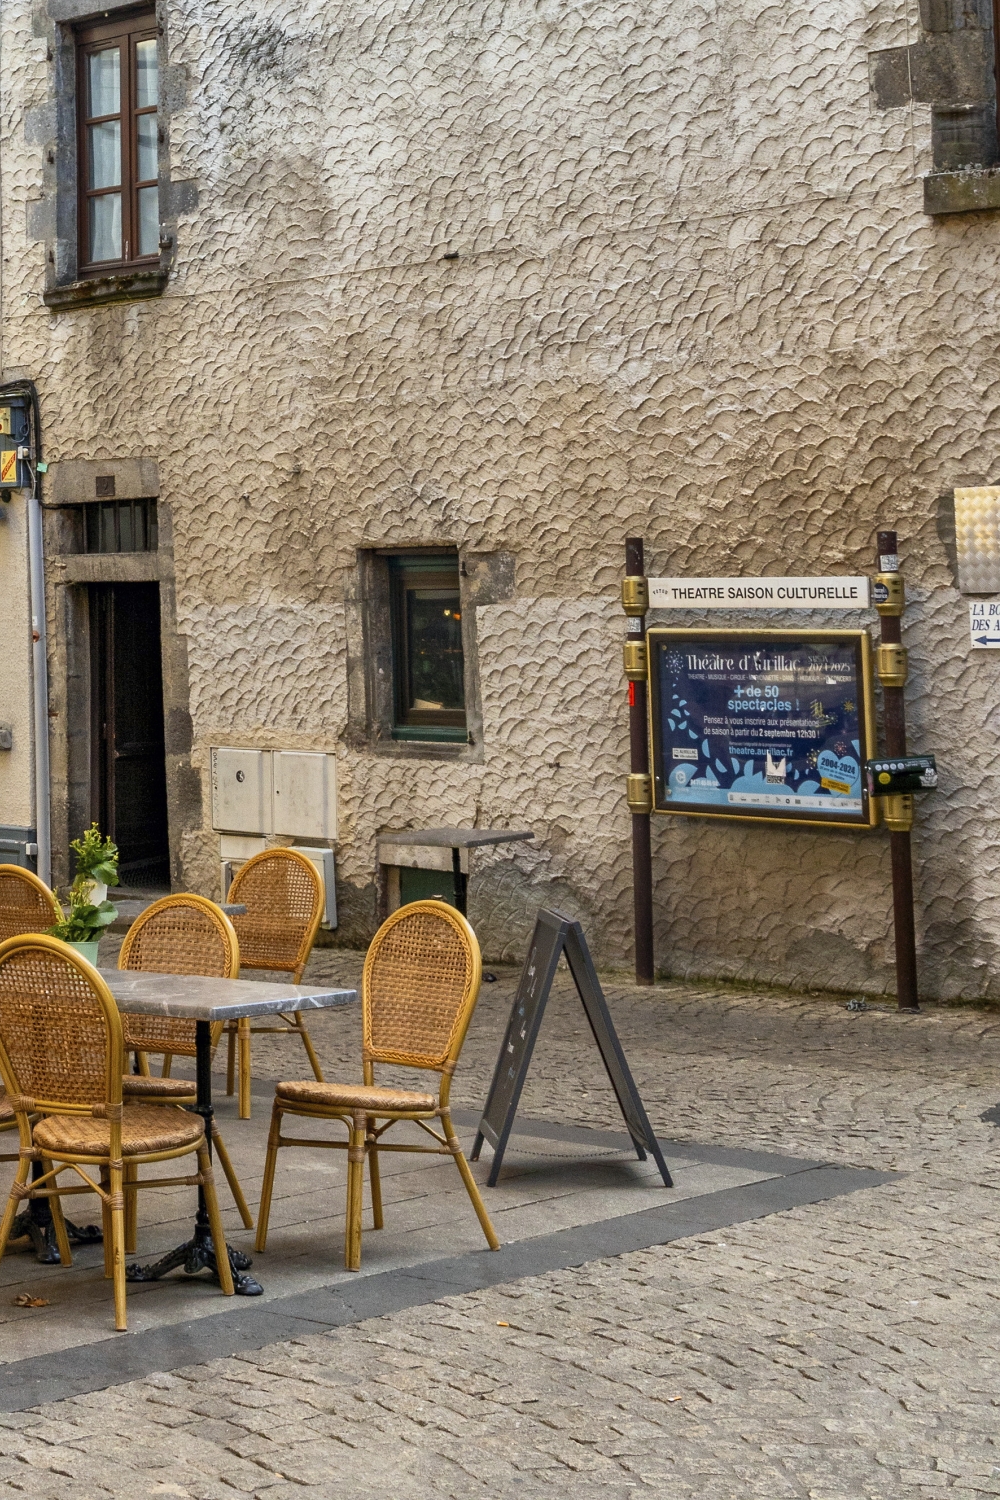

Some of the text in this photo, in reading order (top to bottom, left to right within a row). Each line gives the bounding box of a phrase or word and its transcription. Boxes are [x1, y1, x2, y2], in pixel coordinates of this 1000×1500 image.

[672, 587, 724, 599] THEATRE
[728, 587, 773, 599] SAISON
[777, 587, 858, 599] CULTURELLE
[972, 604, 984, 615] LA
[972, 619, 990, 631] DES
[686, 653, 734, 670] Théâtre
[747, 686, 762, 697] de
[765, 685, 779, 697] 50
[727, 699, 792, 712] spectacles
[704, 716, 723, 725] Pensez
[744, 717, 766, 726] inscrire
[704, 727, 711, 735] de
[712, 727, 729, 735] saison
[735, 728, 749, 737] partir
[751, 728, 758, 736] du
[764, 729, 796, 739] septembre
[797, 730, 816, 738] 12h30
[821, 757, 855, 775] 2004-2024
